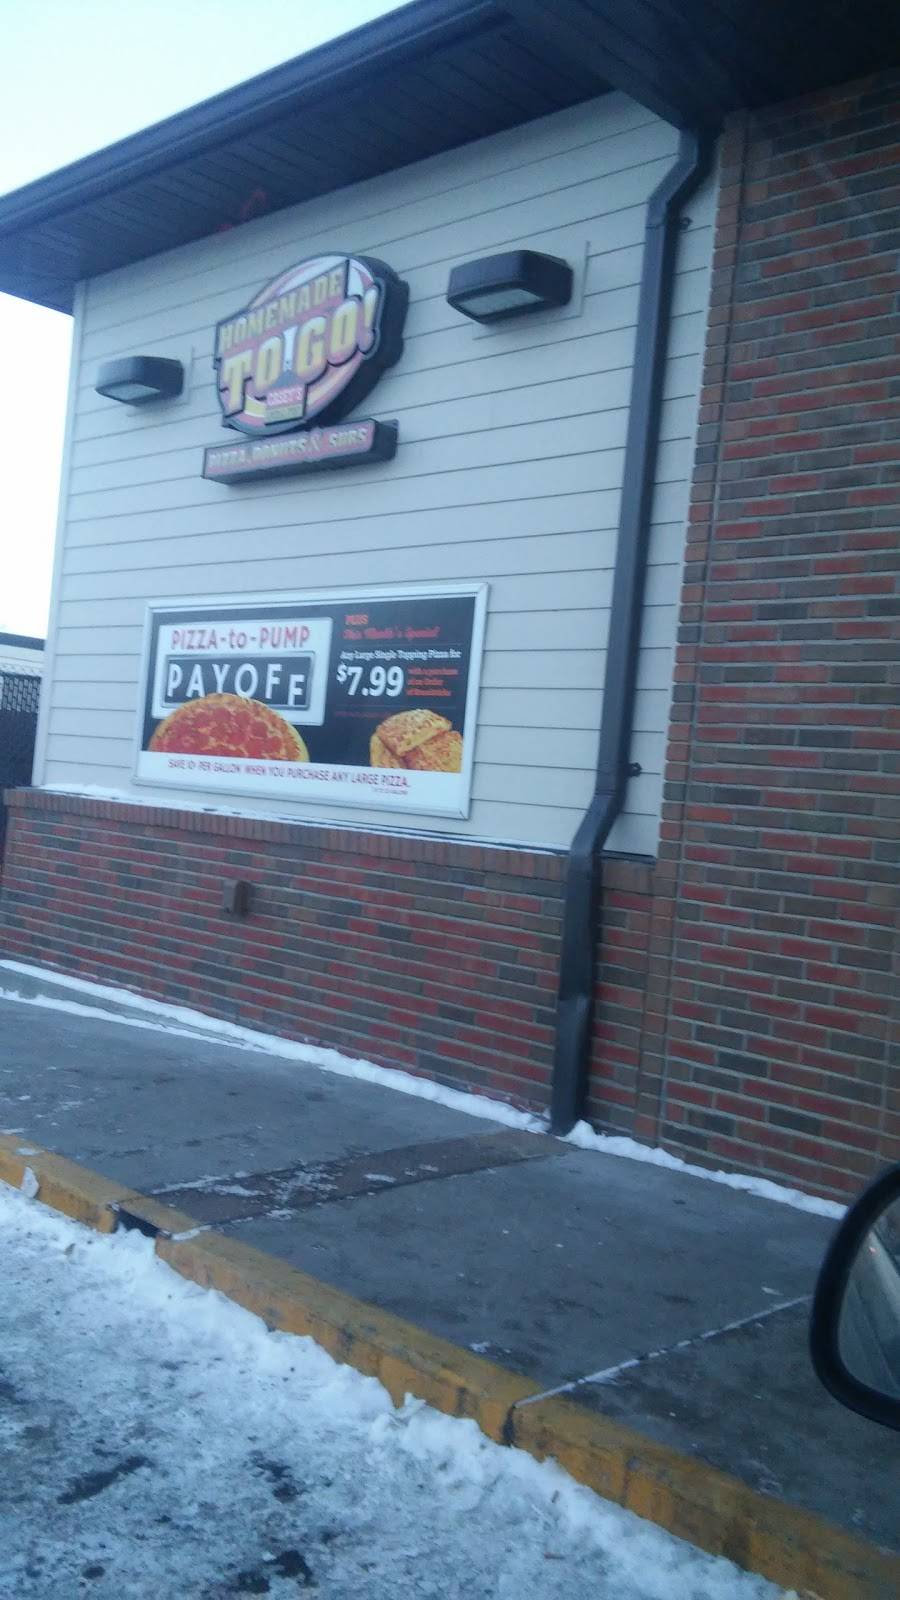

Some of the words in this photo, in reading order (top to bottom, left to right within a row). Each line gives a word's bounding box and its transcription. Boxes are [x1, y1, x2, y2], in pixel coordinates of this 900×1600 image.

[220, 272, 342, 351] HOMEMADE
[223, 335, 282, 410] TO
[296, 287, 378, 379] GO!
[171, 626, 310, 650] PIZZA-to-PUMP
[167, 663, 305, 706] PAYOFF
[336, 661, 404, 697] $7.99
[287, 767, 329, 782] PURCHASE
[332, 771, 348, 782] ANY
[351, 772, 379, 785] LARGE
